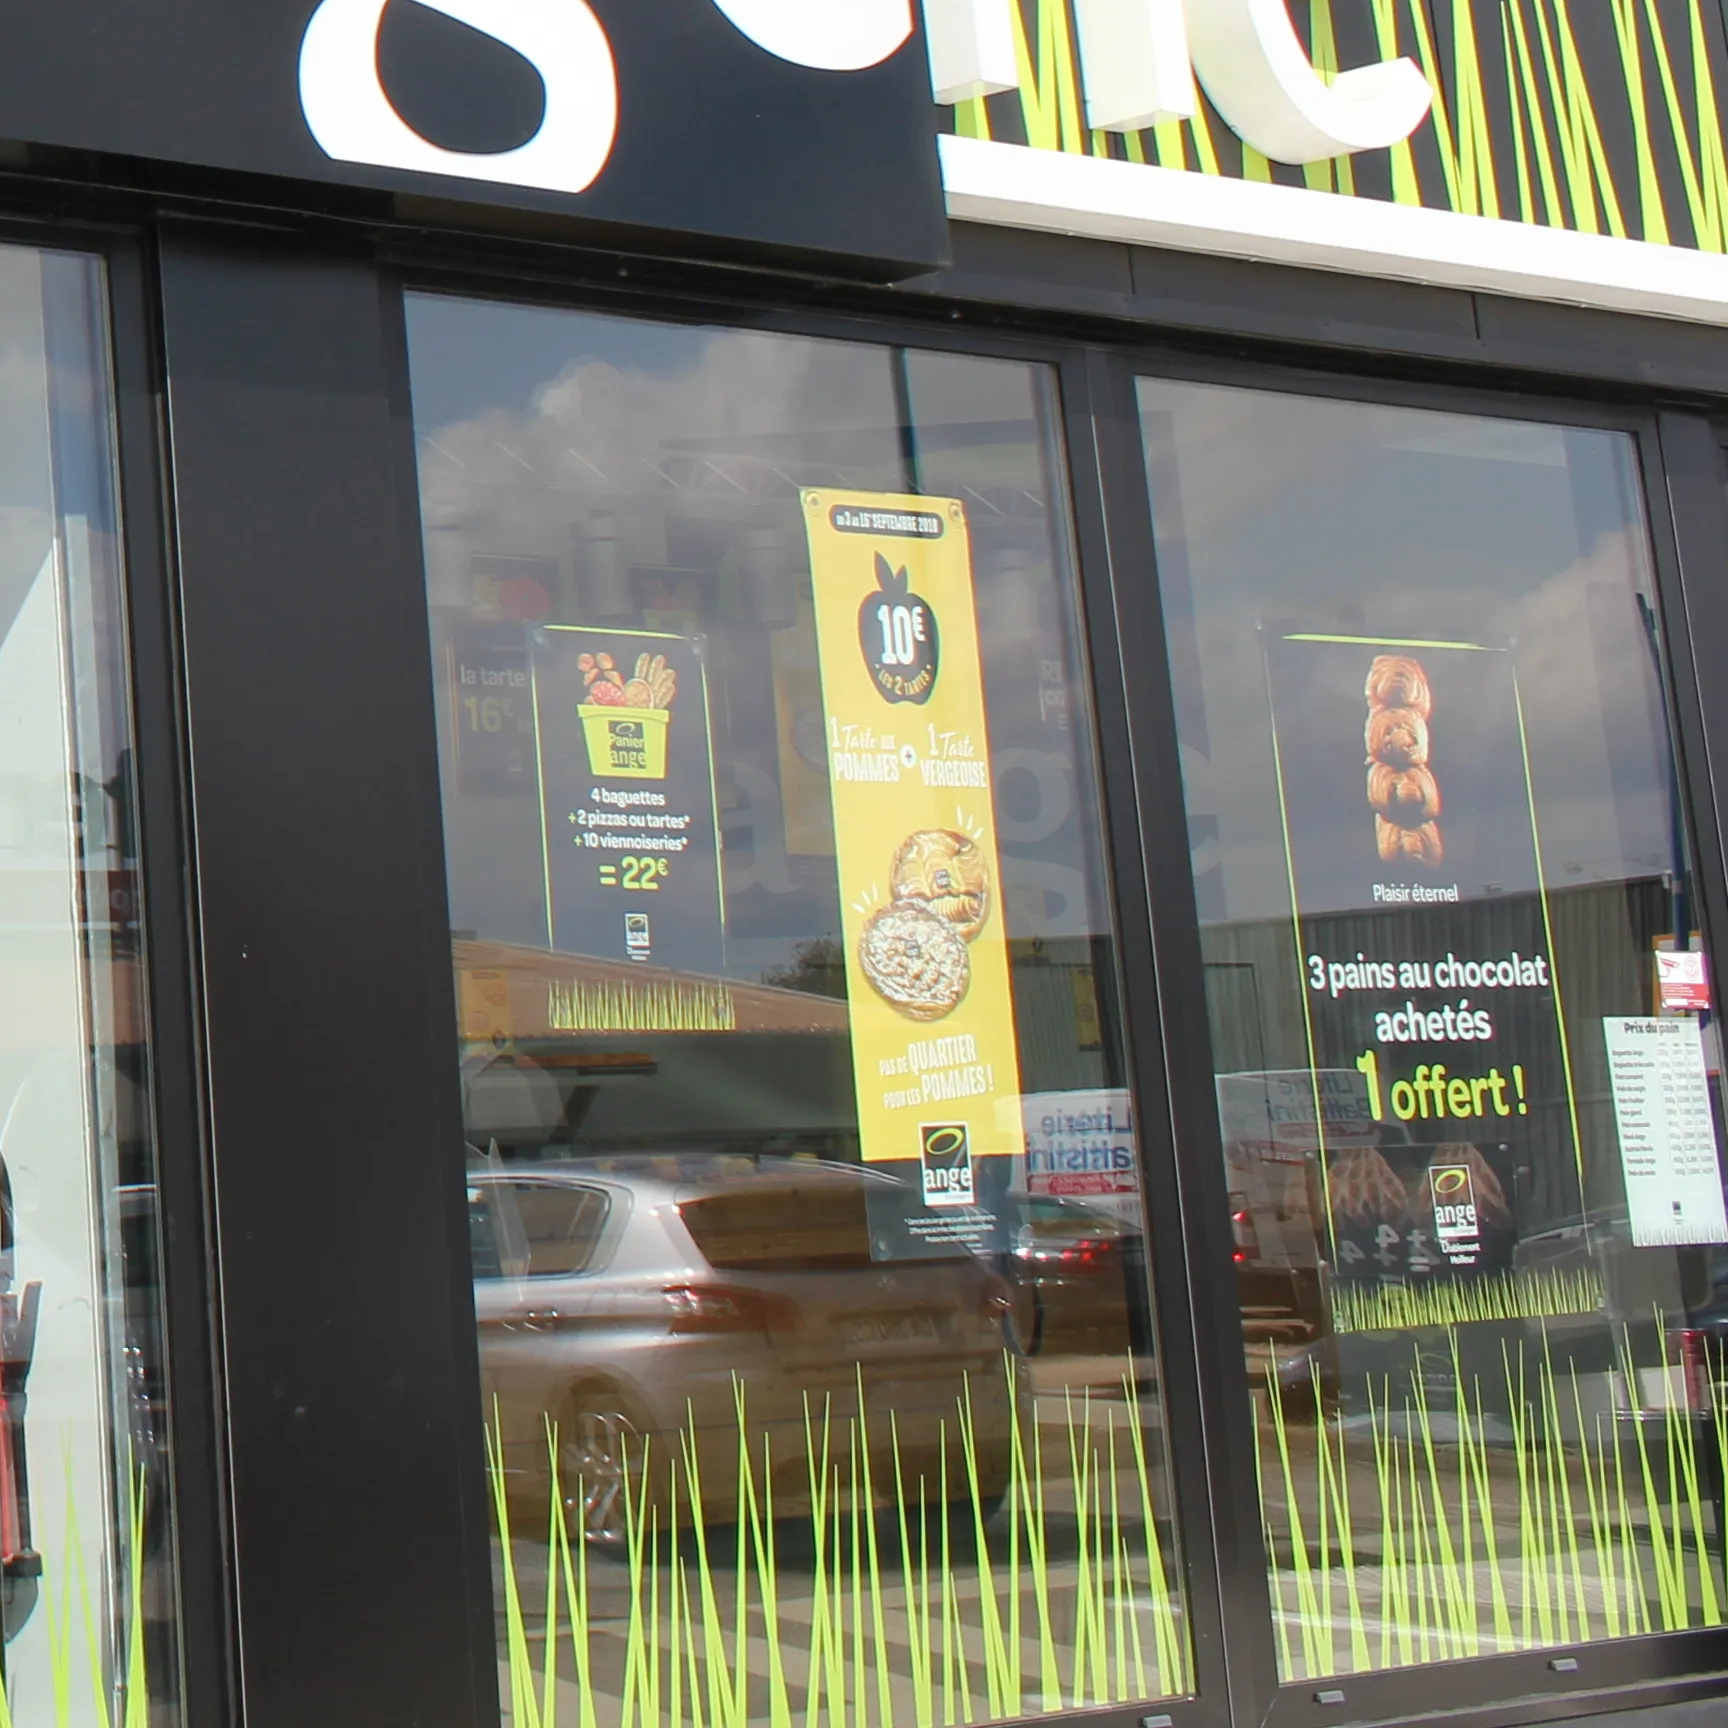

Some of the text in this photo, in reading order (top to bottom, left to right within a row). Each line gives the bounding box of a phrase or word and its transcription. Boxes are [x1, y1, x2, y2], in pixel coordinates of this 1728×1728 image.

[872, 513, 918, 532] SEPTEMBRE
[878, 604, 925, 665] 10€
[895, 677, 903, 696] 2
[609, 733, 646, 749] Panier
[830, 717, 840, 748] 1
[842, 724, 877, 752] Tarte
[927, 722, 976, 757] 1 Tarte
[609, 748, 647, 770] ange
[834, 752, 900, 783] POMMES
[921, 758, 987, 788] VERGEOISE
[590, 787, 665, 807] 4 baguettes
[588, 810, 628, 828] pizzas
[629, 815, 645, 827] ou
[621, 856, 669, 890] 22€
[1373, 883, 1459, 903] Plaisir éternel
[1308, 952, 1549, 998] 3 pains au chocolat
[1374, 998, 1492, 1043] achetés
[1624, 1021, 1680, 1035] Prix du pain
[879, 1033, 978, 1076] PAS DE QUARTIER
[884, 1091, 906, 1109] POUR
[906, 1087, 921, 1106] LES
[921, 1067, 986, 1103] POMMES
[1356, 1049, 1382, 1122] 1
[1390, 1063, 1510, 1121] offert
[924, 1167, 972, 1193] ange
[1434, 1205, 1476, 1227] ange
